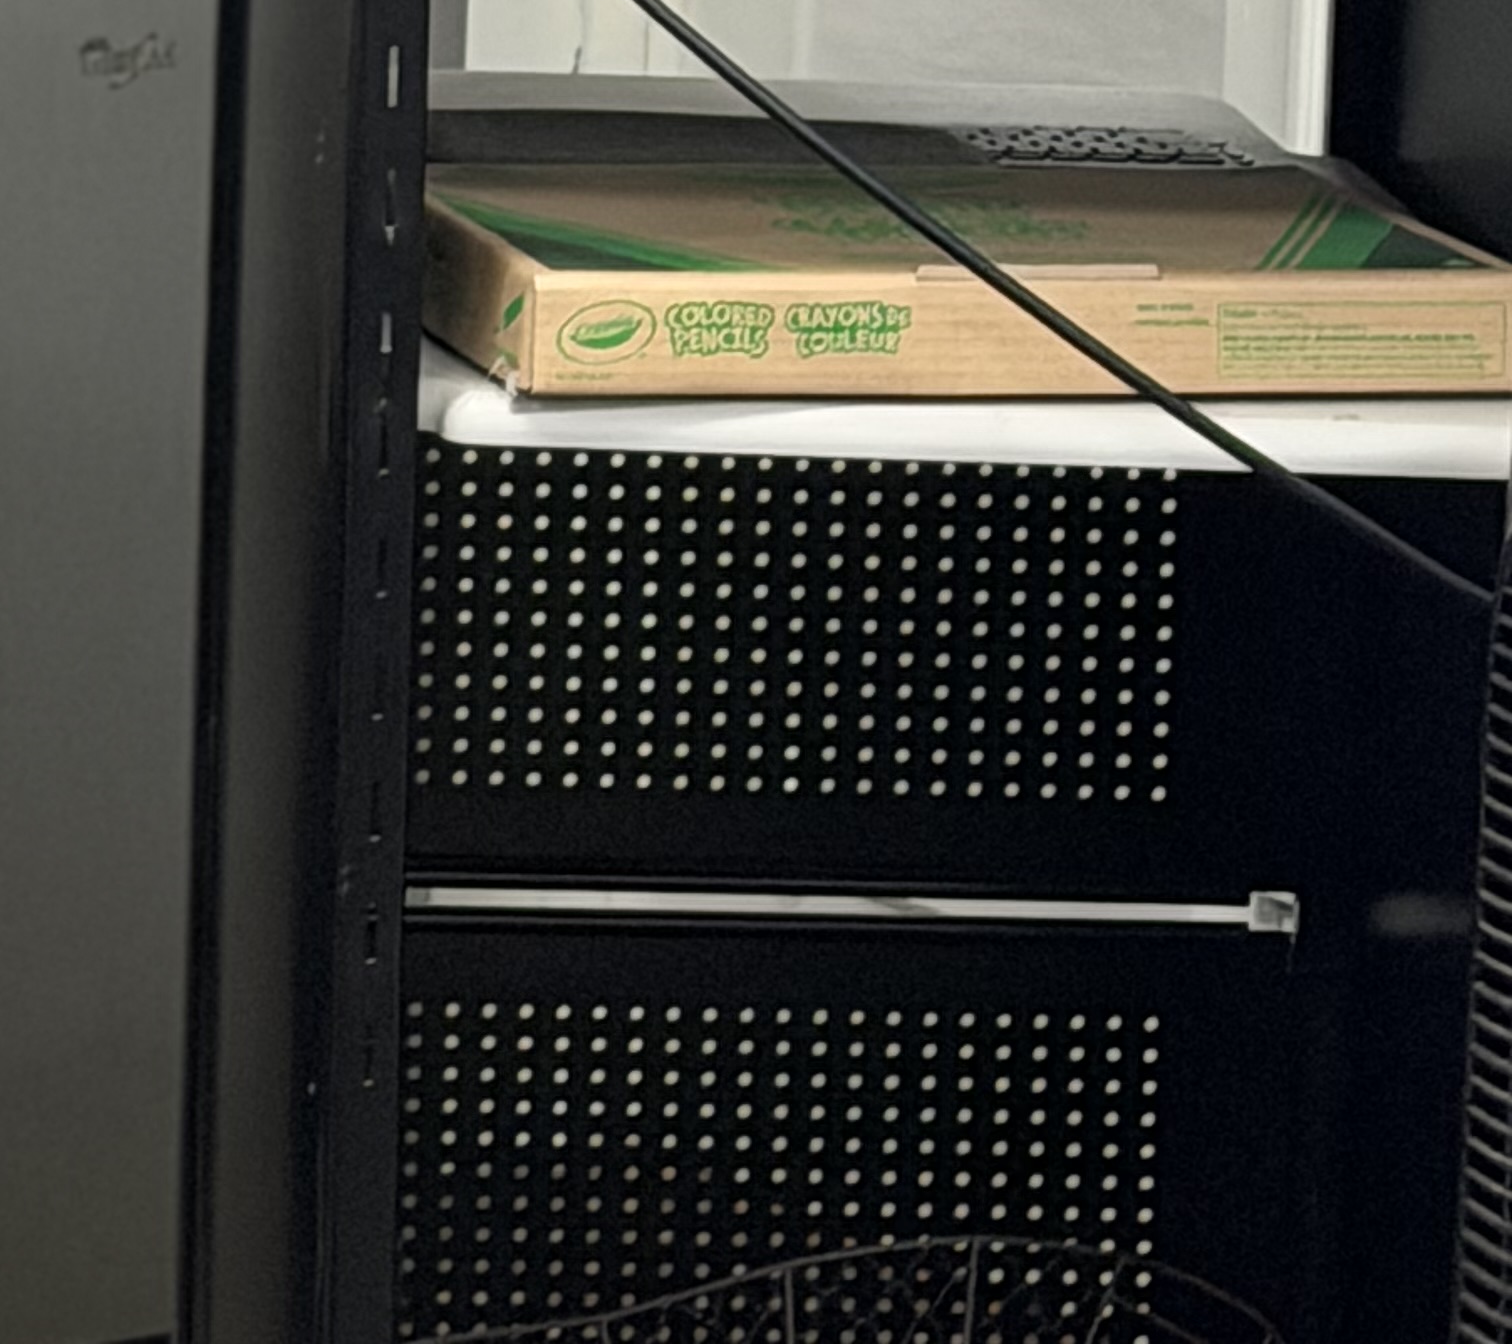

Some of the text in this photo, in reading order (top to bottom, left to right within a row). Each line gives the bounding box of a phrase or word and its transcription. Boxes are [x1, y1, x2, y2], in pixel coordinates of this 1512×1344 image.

[666, 302, 774, 330] COLORED
[786, 302, 885, 331] CRAYONS
[672, 327, 768, 358] PENCILS
[795, 328, 902, 357] COULEUR
